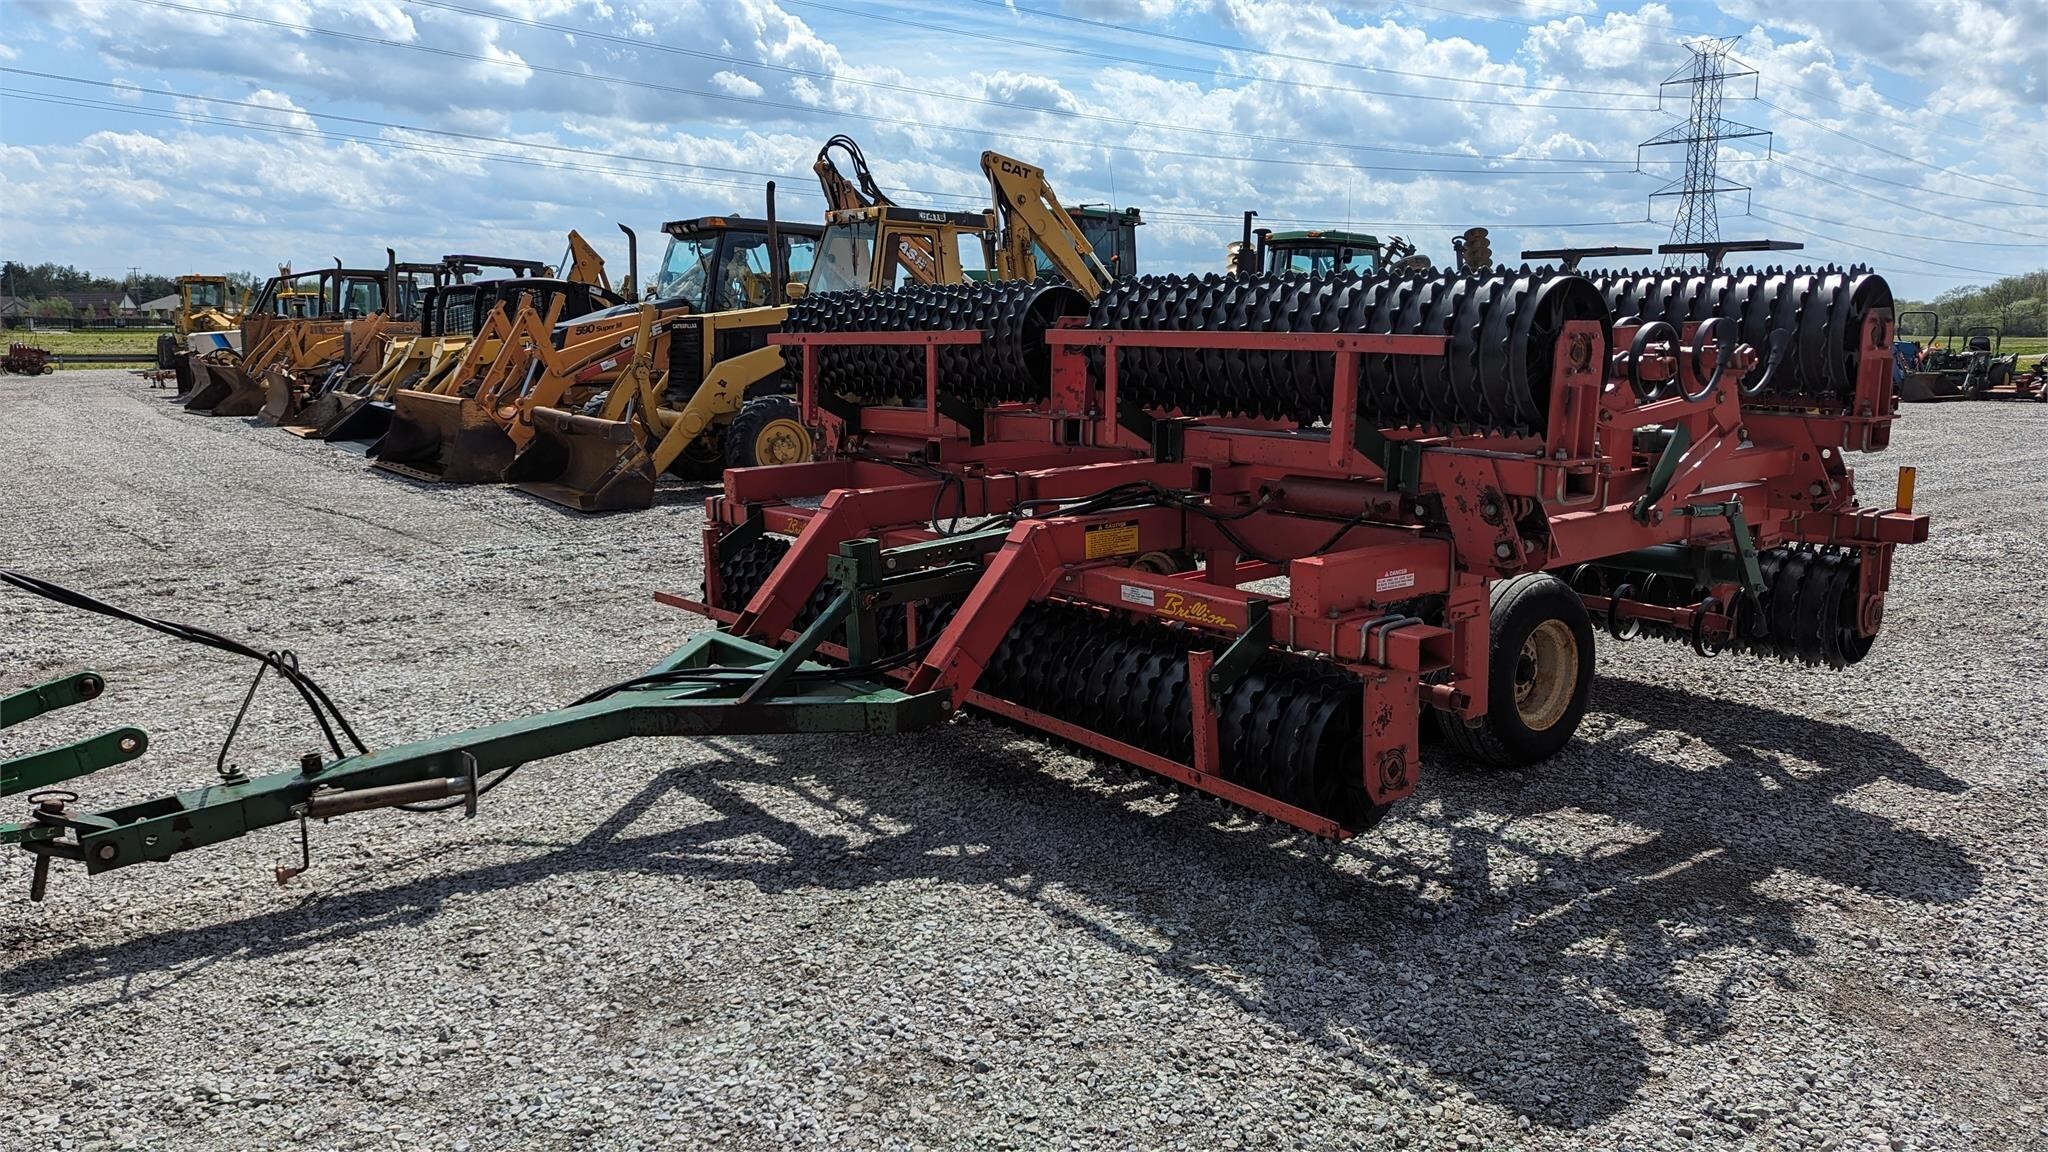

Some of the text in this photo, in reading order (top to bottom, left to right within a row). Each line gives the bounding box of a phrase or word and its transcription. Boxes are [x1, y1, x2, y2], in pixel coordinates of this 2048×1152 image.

[1001, 161, 1032, 179] CAT
[324, 326, 344, 334] CAS
[403, 325, 420, 334] CA
[575, 324, 595, 336] 590
[596, 324, 615, 333] Super
[1155, 592, 1237, 629] Brillion
